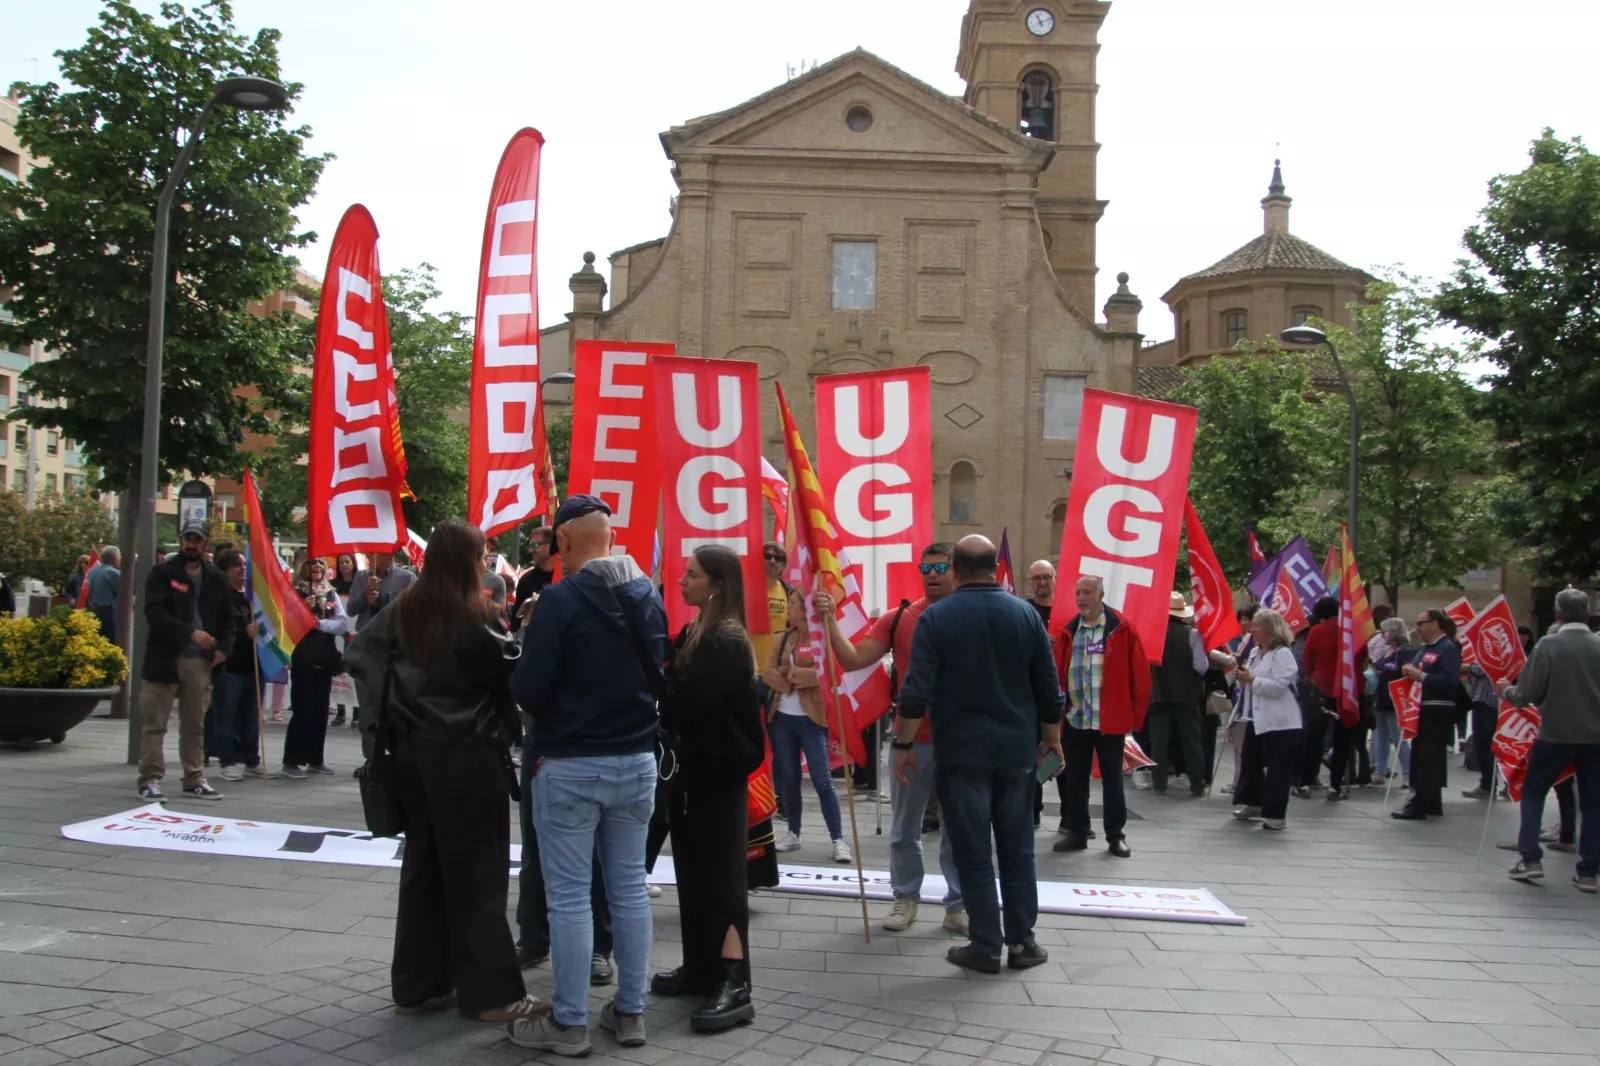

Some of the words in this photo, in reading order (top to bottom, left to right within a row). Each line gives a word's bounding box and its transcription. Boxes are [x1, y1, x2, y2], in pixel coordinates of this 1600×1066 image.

[479, 199, 538, 533] CCOO
[328, 266, 398, 545] CCOO
[590, 351, 647, 556] CCO
[834, 380, 913, 617] UGT
[1079, 404, 1177, 614] UGT
[1191, 566, 1215, 623] GT
[1285, 553, 1332, 602] CC
[1501, 712, 1540, 743] UG
[165, 831, 215, 844] Aragón
[779, 871, 891, 885] CHOS
[1072, 888, 1146, 899] UGT
